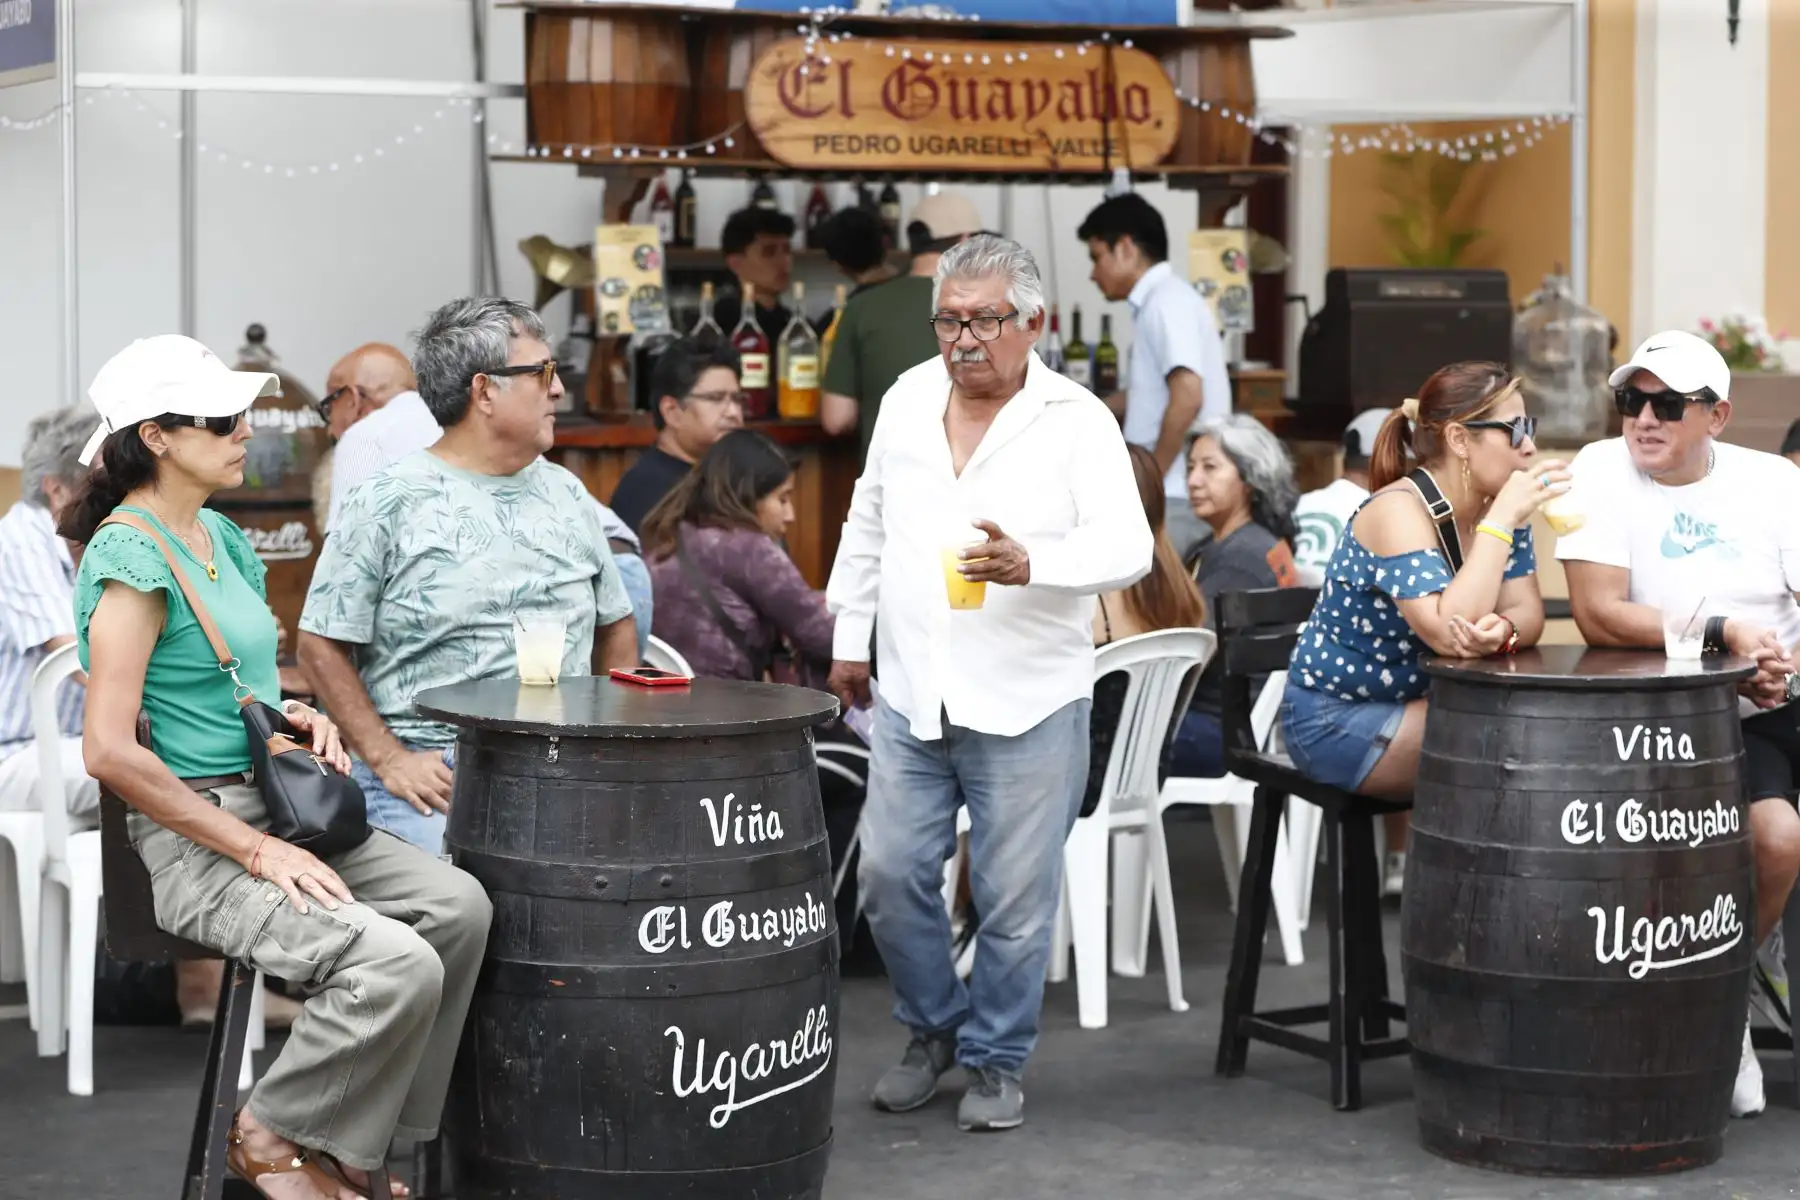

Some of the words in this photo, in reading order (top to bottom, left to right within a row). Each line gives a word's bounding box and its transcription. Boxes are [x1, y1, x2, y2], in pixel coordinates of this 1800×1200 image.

[777, 55, 856, 119] El
[814, 135, 900, 155] PEDRO
[909, 136, 1032, 157] UGARELLI
[1049, 137, 1122, 157] VALLE
[1612, 725, 1696, 761] Viña
[700, 793, 785, 848] Viña
[1561, 799, 1606, 845] El
[1616, 798, 1740, 848] Guayabo
[638, 905, 692, 953] El
[701, 892, 827, 949] Guayabo
[1587, 893, 1743, 980] Ugarelli
[664, 1004, 833, 1129] Ugarelli
